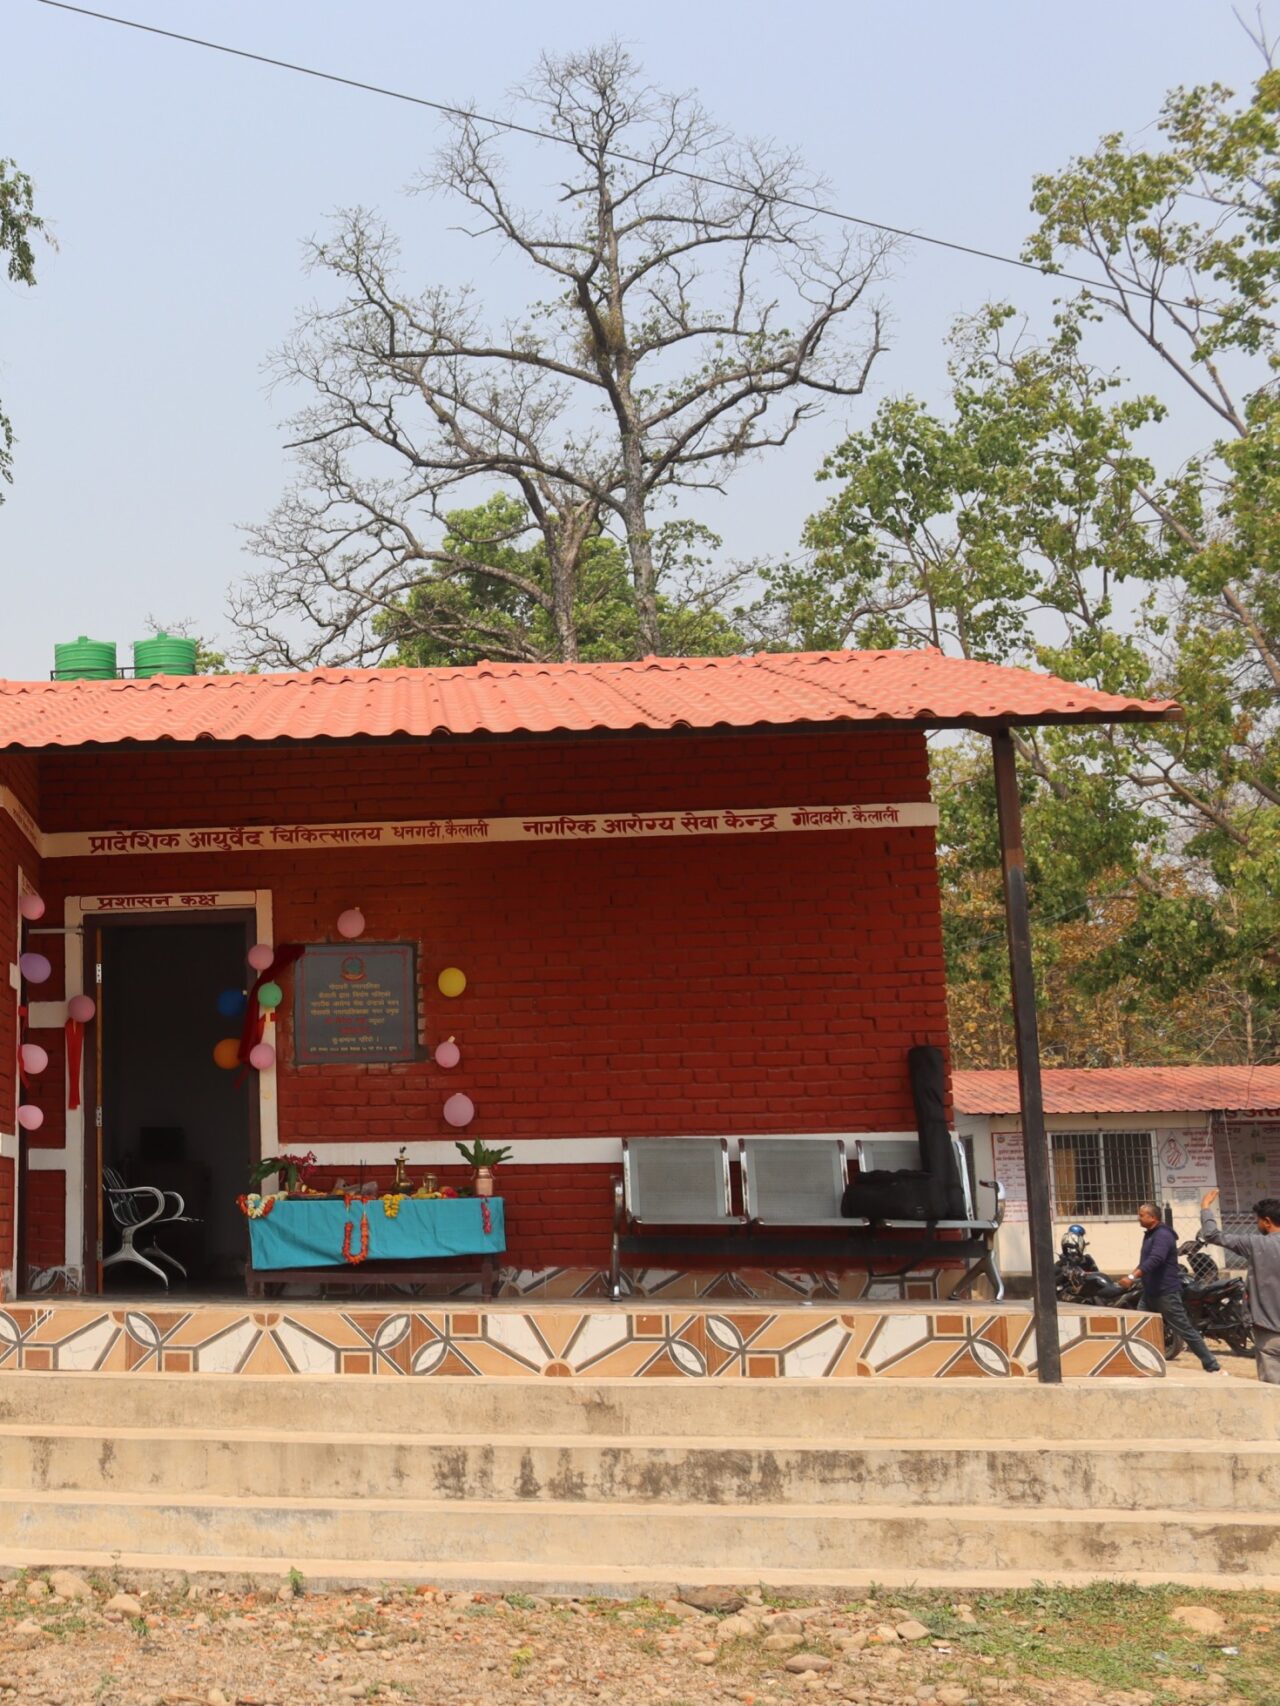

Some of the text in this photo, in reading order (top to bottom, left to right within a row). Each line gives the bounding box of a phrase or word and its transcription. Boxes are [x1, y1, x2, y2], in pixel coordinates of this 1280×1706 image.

[522, 816, 597, 836] नागरिक
[601, 813, 675, 834] आरोग्य
[681, 812, 719, 832] सेवा
[722, 810, 778, 832] केन्द्र
[852, 805, 900, 824] कैलाली
[88, 831, 181, 854] प्रादेशिक
[185, 827, 264, 851] आयुर्वेद
[270, 825, 384, 844] चिकित्सालय
[96, 894, 220, 910] प्रशासन कक्ष
